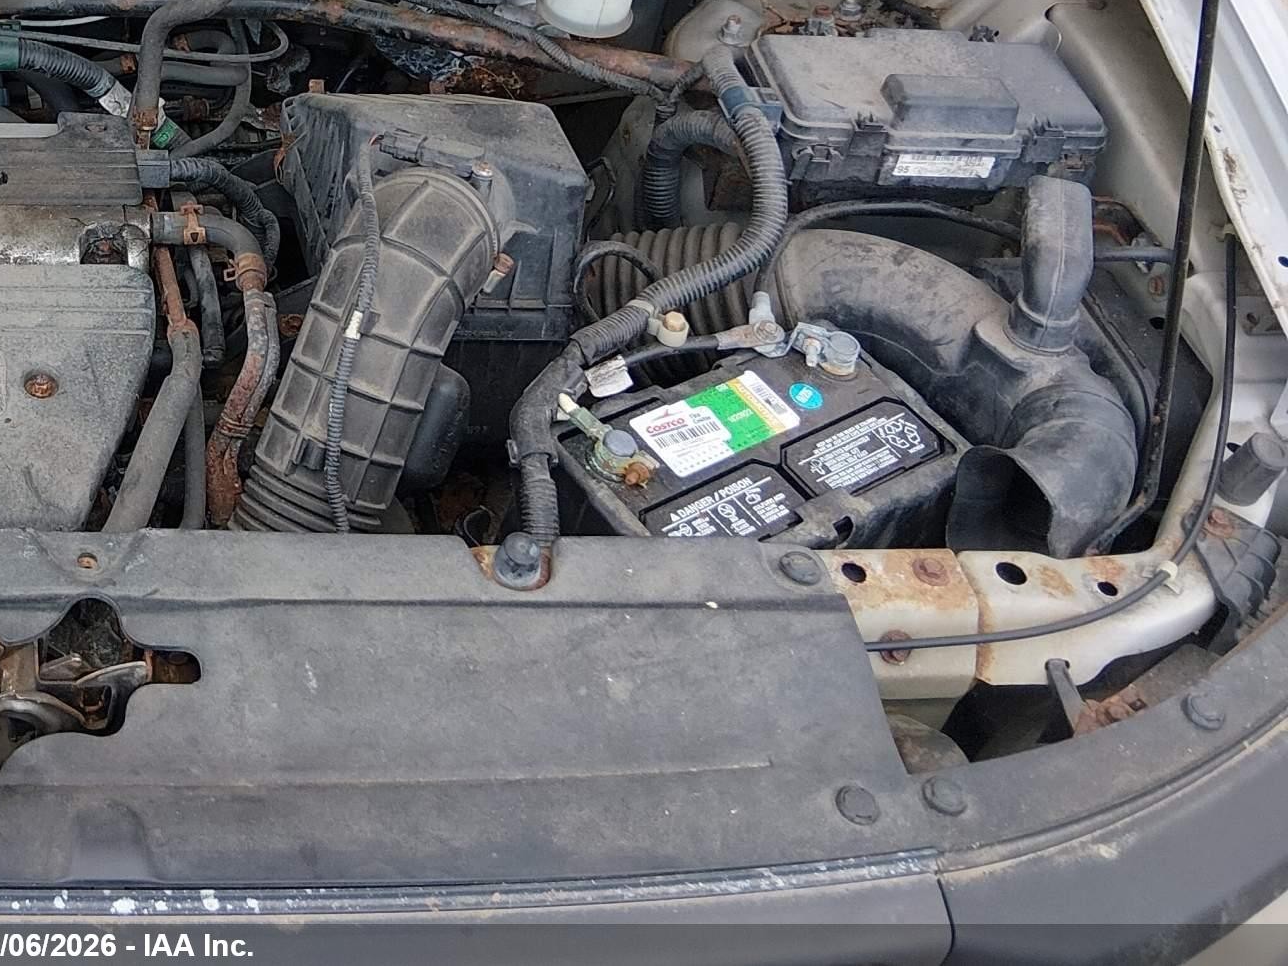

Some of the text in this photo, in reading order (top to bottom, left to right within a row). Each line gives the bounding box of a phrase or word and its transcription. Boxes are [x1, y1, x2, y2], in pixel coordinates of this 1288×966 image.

[646, 417, 685, 434] COSTCO
[676, 495, 715, 518] DANGER
[718, 476, 753, 498] POISON
